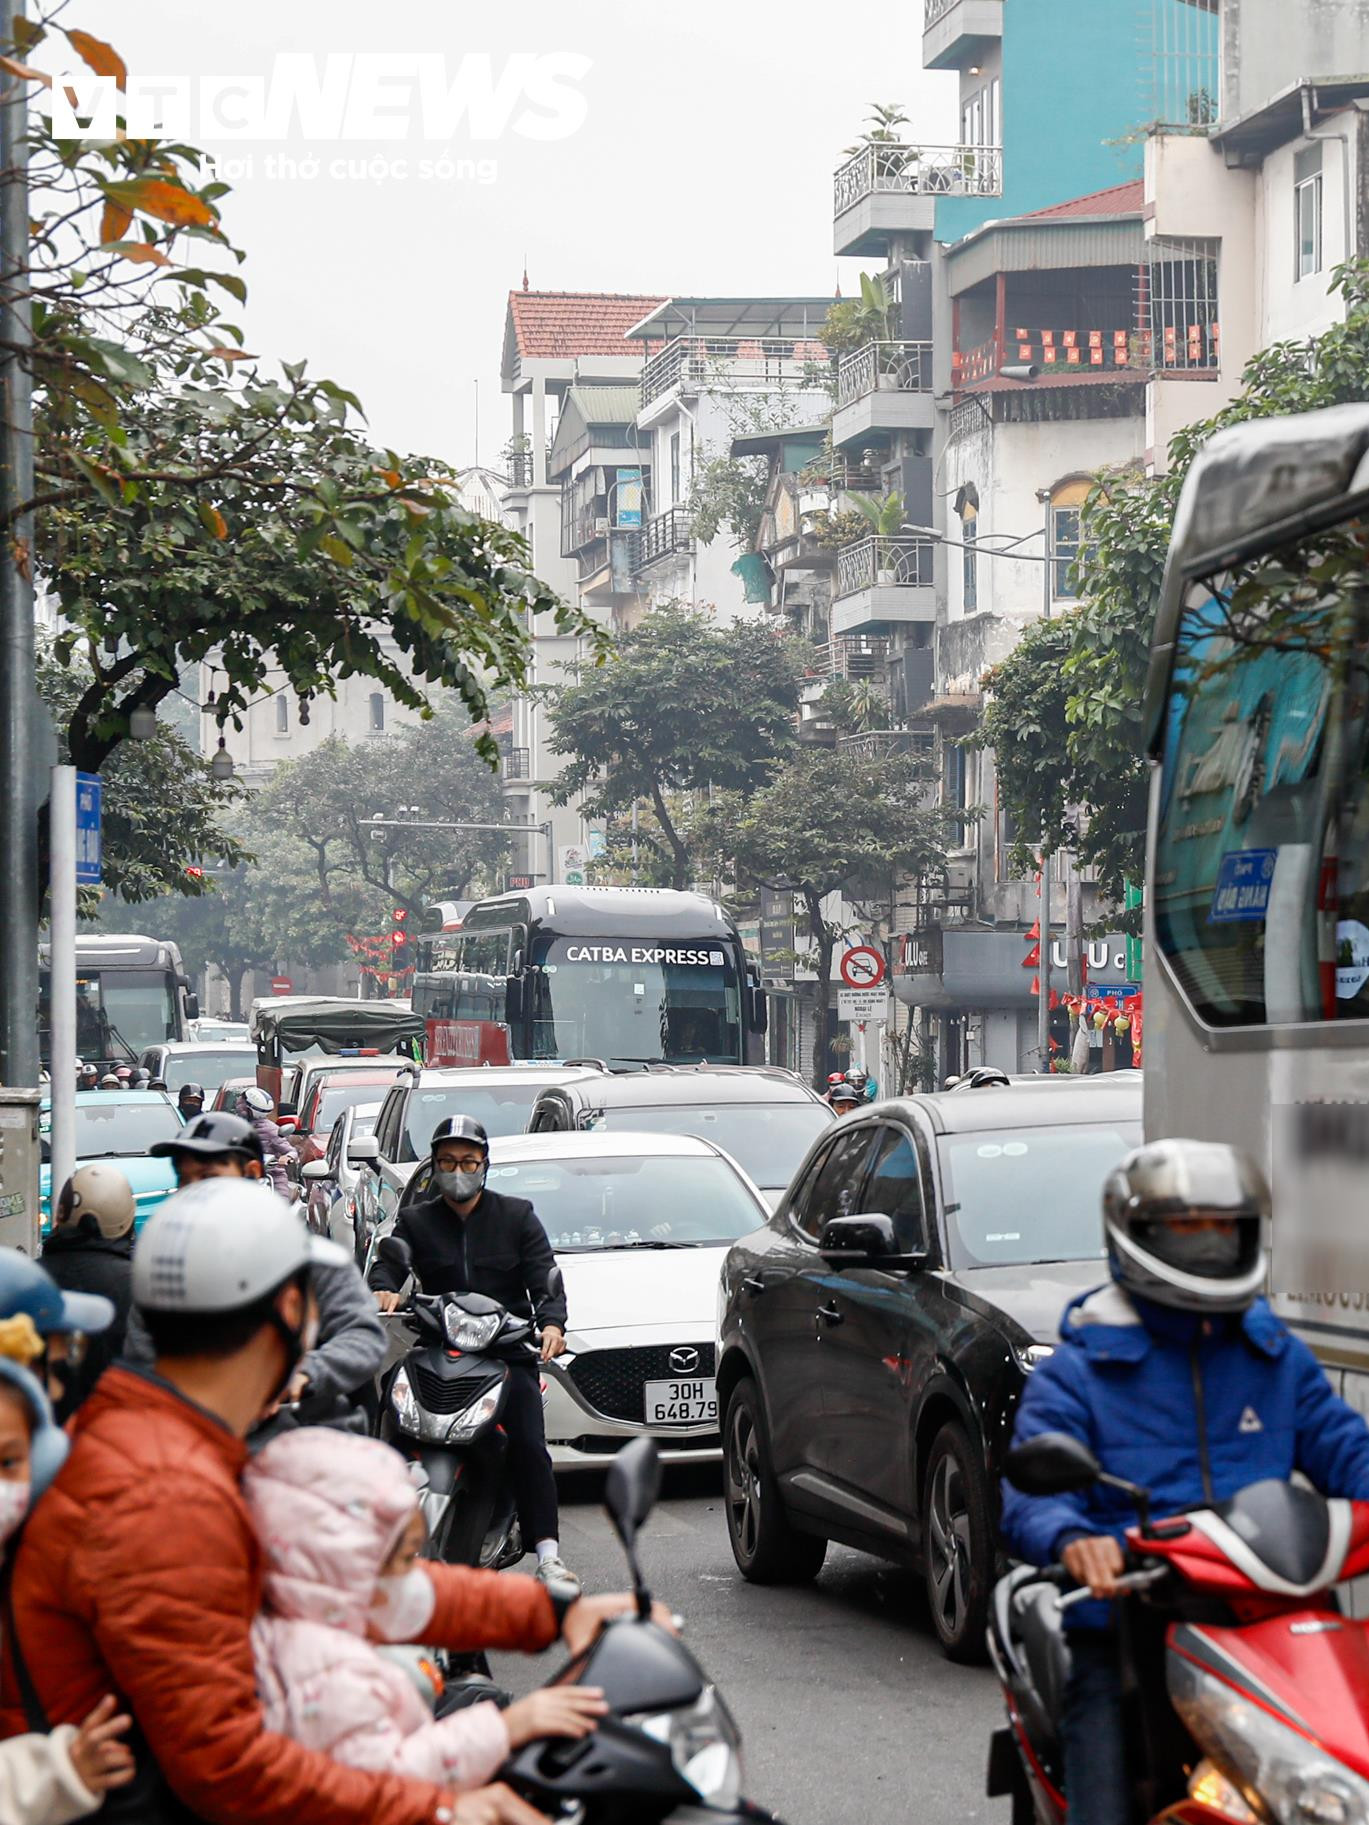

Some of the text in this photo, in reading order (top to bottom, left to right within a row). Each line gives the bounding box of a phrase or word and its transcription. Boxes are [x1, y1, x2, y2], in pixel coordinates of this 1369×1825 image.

[566, 946, 709, 966] CATBA EXPRESS
[669, 1383, 704, 1400] 30H
[655, 1401, 717, 1421] 648.79
